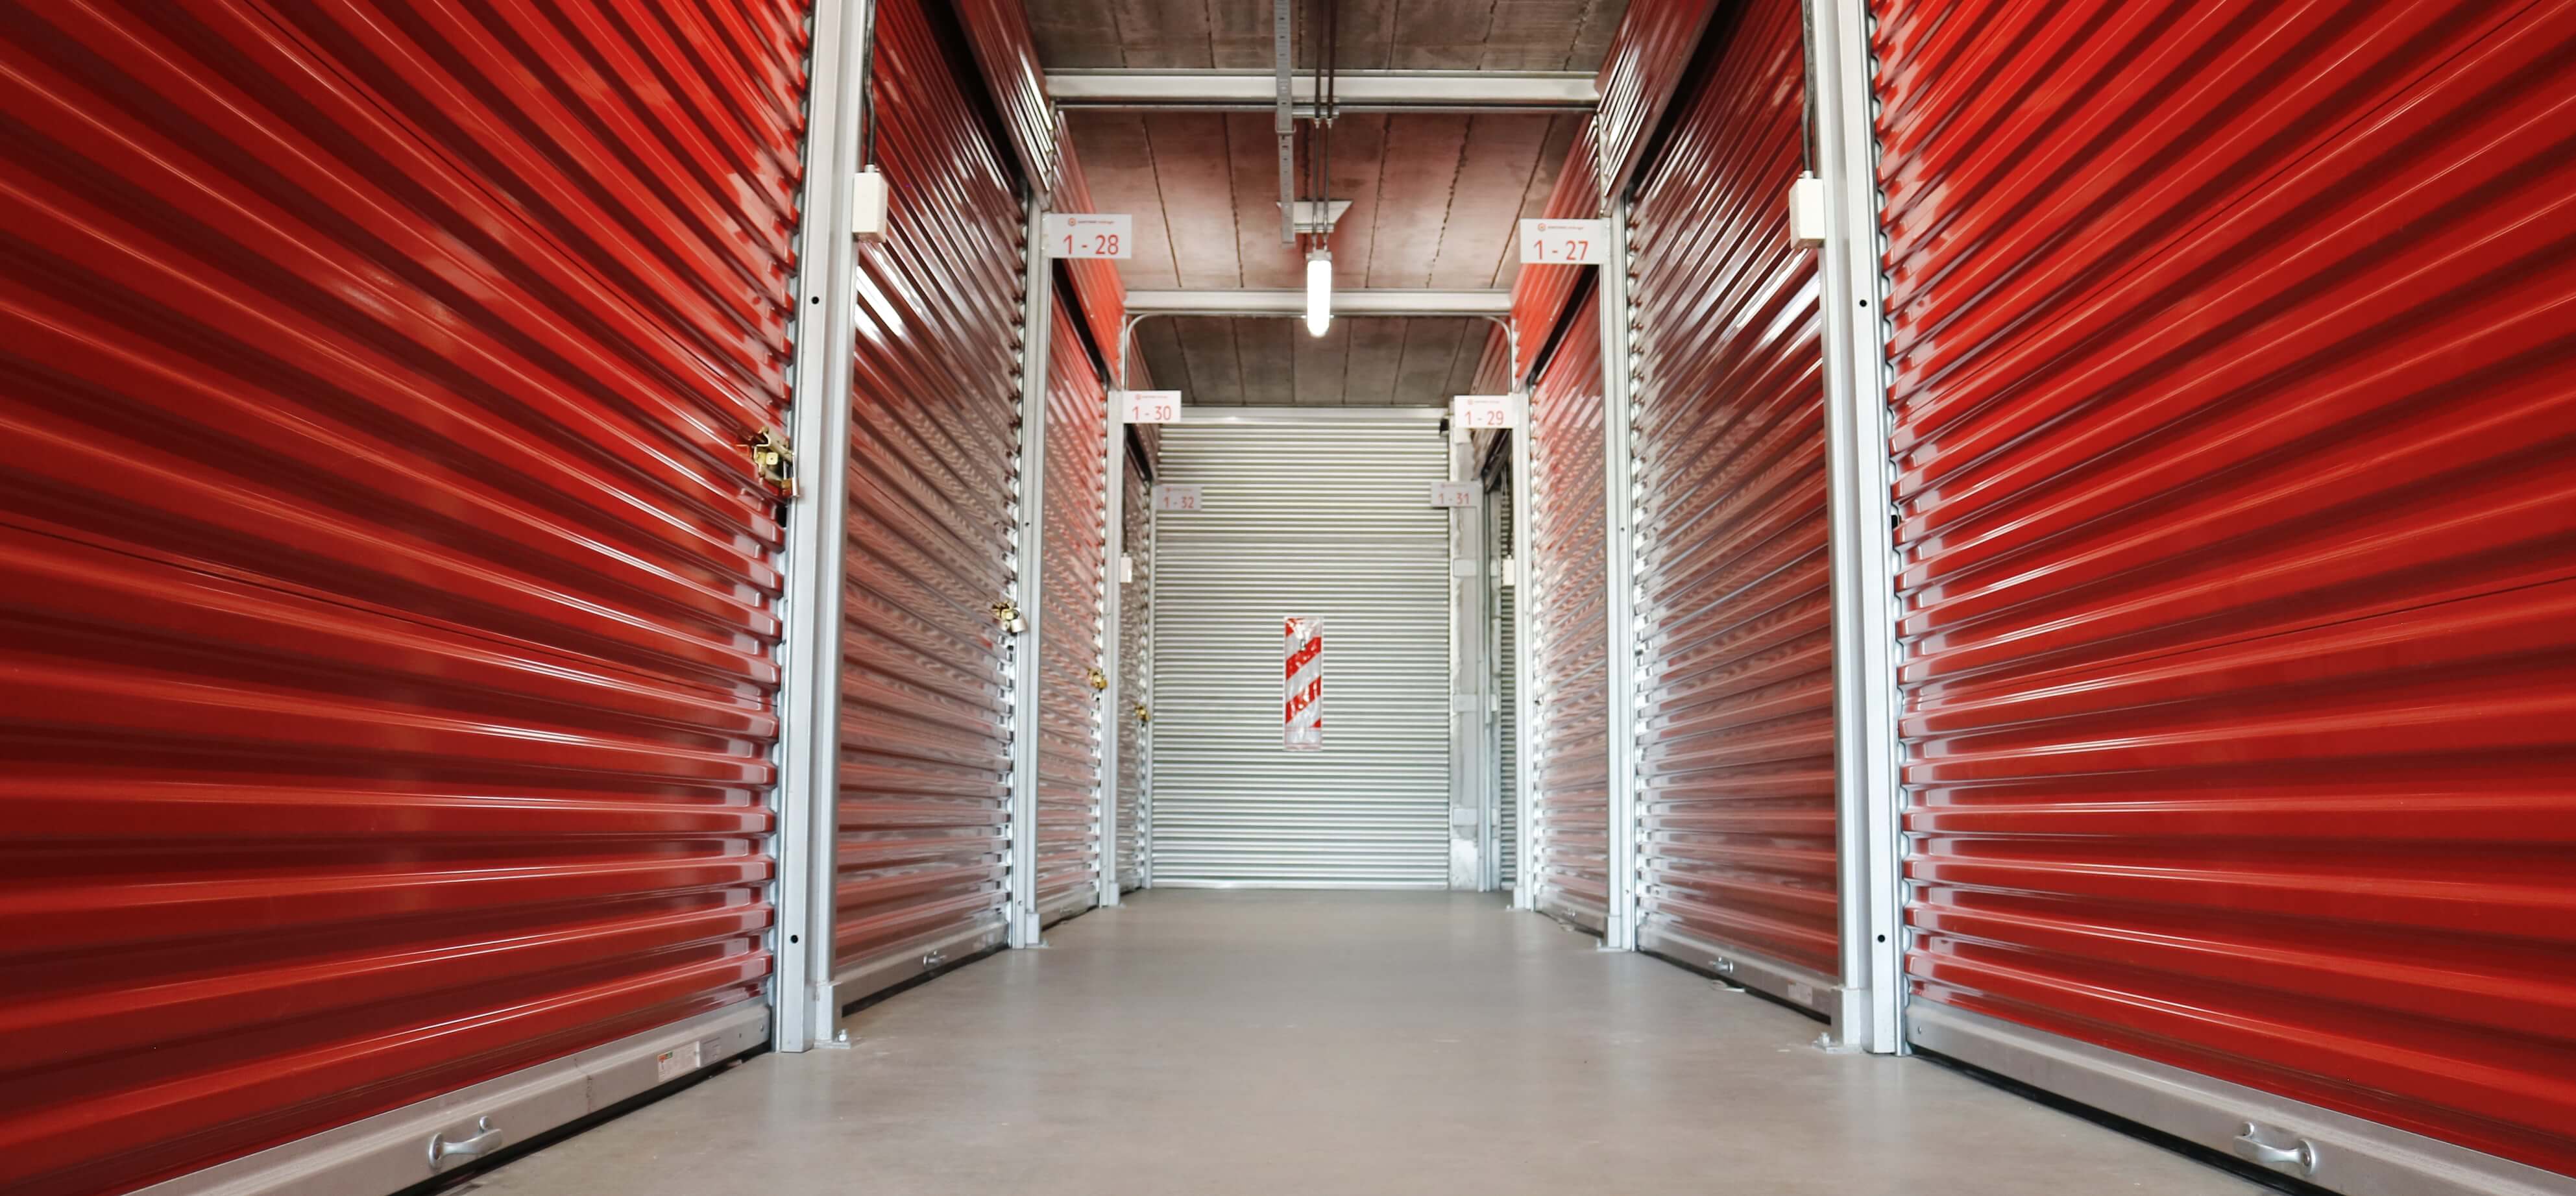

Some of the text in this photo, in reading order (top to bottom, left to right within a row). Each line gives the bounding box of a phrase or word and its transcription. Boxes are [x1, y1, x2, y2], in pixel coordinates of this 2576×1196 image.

[1063, 234, 1073, 255] 1
[1095, 234, 1119, 255] 28
[1533, 239, 1543, 260] 1
[1566, 239, 1589, 260] 27
[1132, 406, 1139, 421] 1
[1154, 406, 1172, 421] 30
[1464, 410, 1472, 426] 1
[1487, 410, 1504, 426] 29
[1163, 496, 1169, 508] 1
[1181, 496, 1195, 508] 32
[1439, 493, 1444, 504] 1
[1456, 493, 1470, 504] 31
